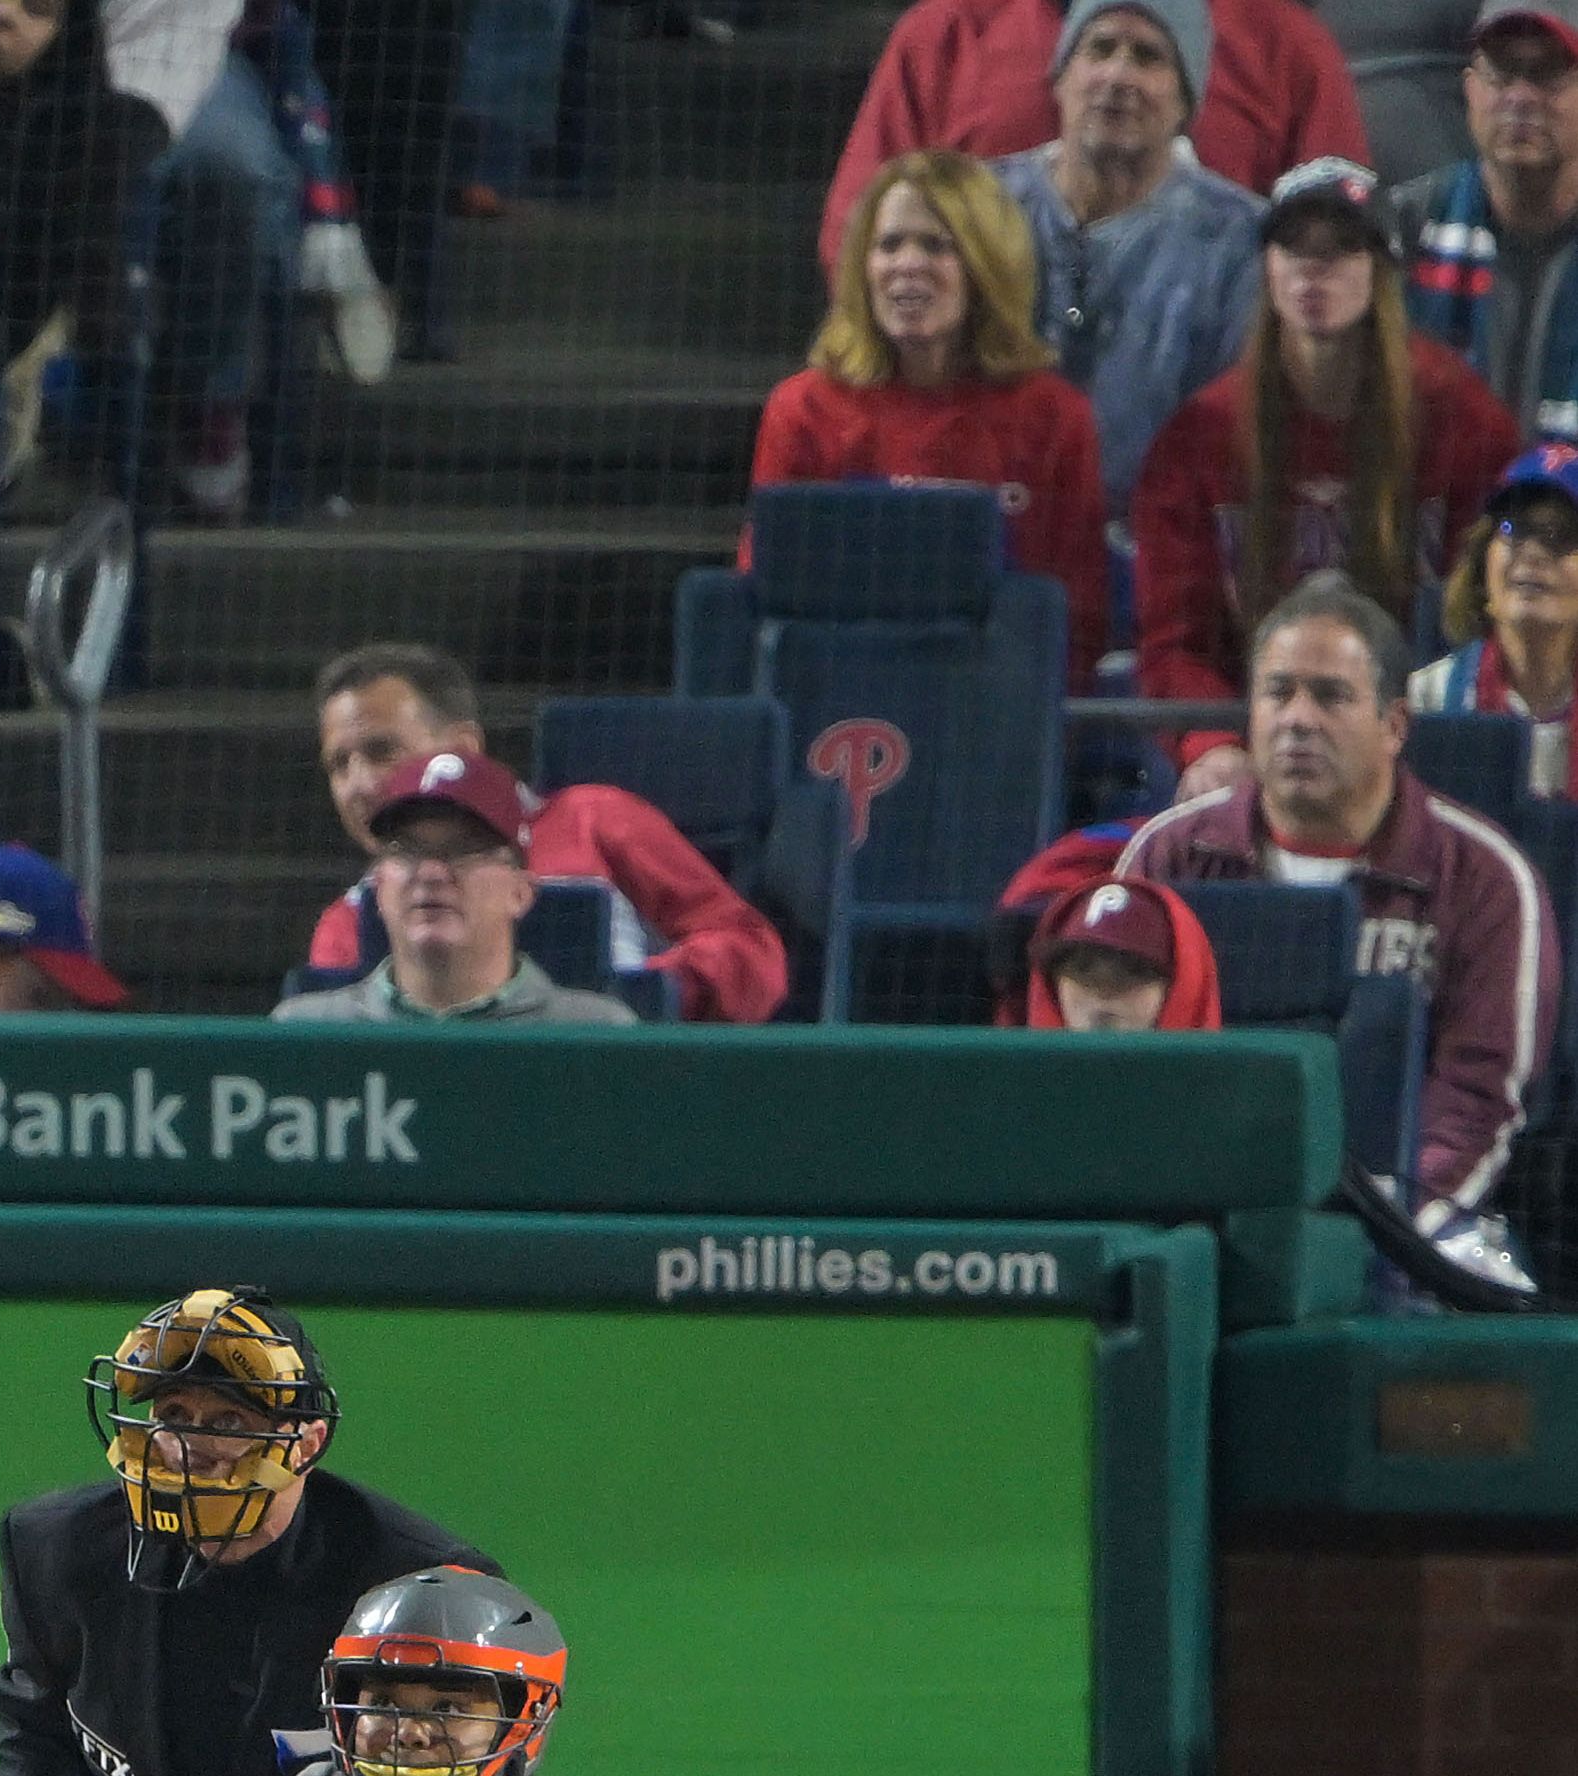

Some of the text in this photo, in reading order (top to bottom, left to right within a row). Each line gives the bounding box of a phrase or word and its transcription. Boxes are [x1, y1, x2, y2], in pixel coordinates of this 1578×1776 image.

[807, 717, 911, 851] P
[1085, 884, 1129, 928] P
[210, 1071, 419, 1163] Park
[656, 1235, 1059, 1299] phillies.com
